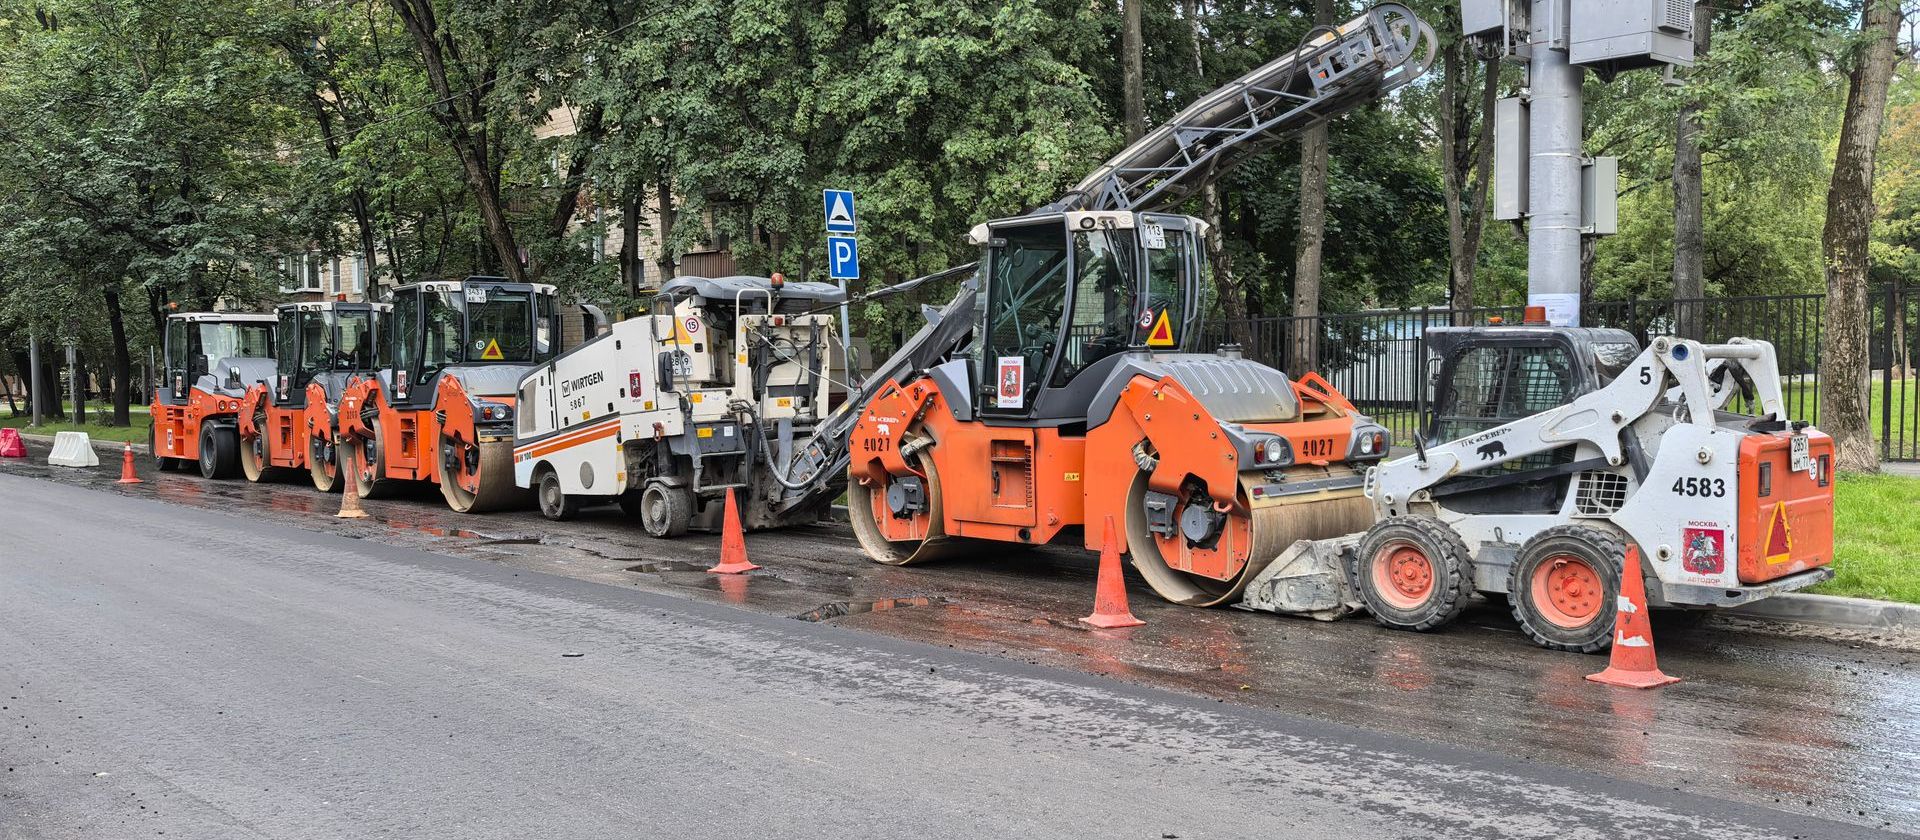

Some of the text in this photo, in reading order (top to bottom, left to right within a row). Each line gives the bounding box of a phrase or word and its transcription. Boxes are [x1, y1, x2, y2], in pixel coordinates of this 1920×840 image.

[1156, 239, 1164, 247] 77
[835, 241, 852, 274] P
[688, 321, 697, 330] 15
[671, 357, 689, 366] 289
[571, 370, 604, 391] WIRTGEN
[1640, 366, 1652, 386] 5
[570, 396, 586, 411] 5867
[864, 438, 890, 452] 4027
[1302, 438, 1334, 457] 4027
[1461, 439, 1474, 448] ПК
[1793, 437, 1807, 452] 2851
[1802, 456, 1808, 467] 77
[1810, 462, 1816, 475] 25
[1672, 477, 1726, 498] 4583
[1688, 520, 1718, 528] МОСКВА
